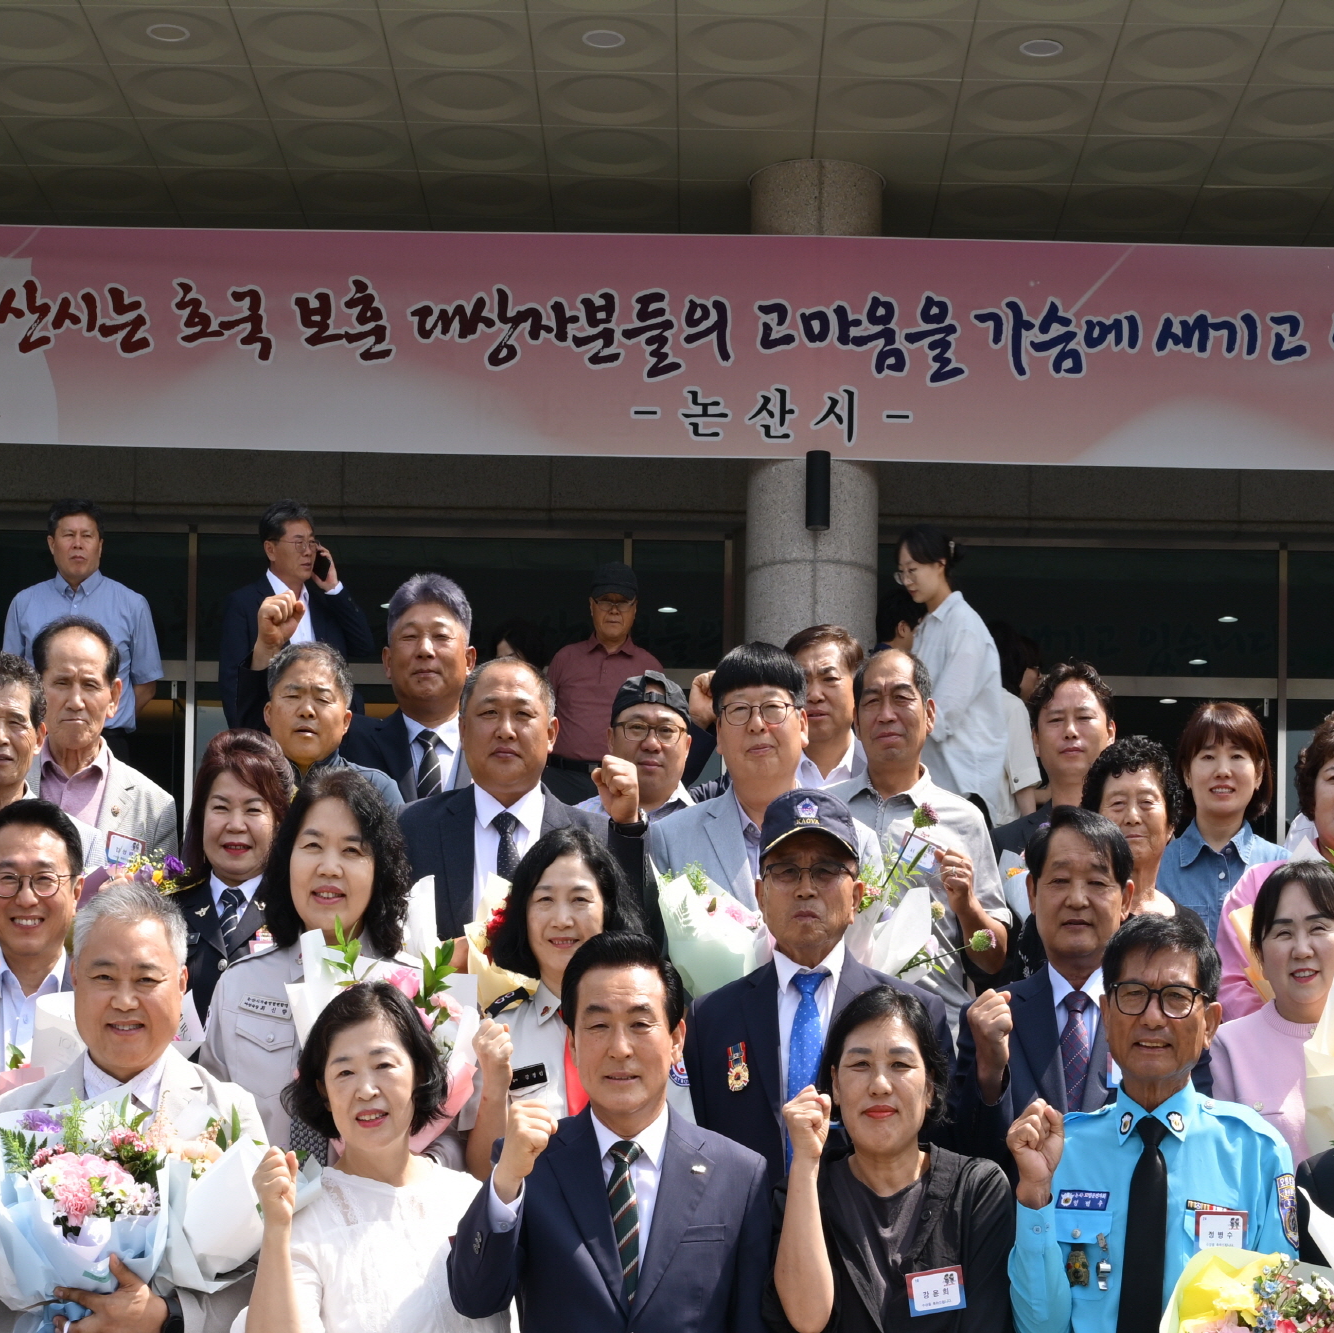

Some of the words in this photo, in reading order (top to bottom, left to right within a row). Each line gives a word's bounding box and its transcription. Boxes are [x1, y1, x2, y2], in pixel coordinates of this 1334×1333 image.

[174, 281, 274, 362] 호국
[296, 279, 394, 361] 보훈
[411, 287, 732, 378] 대상자분들의
[757, 294, 966, 383] 고마움을
[973, 299, 1138, 377] 가슴에
[1155, 312, 1308, 361] 새기고
